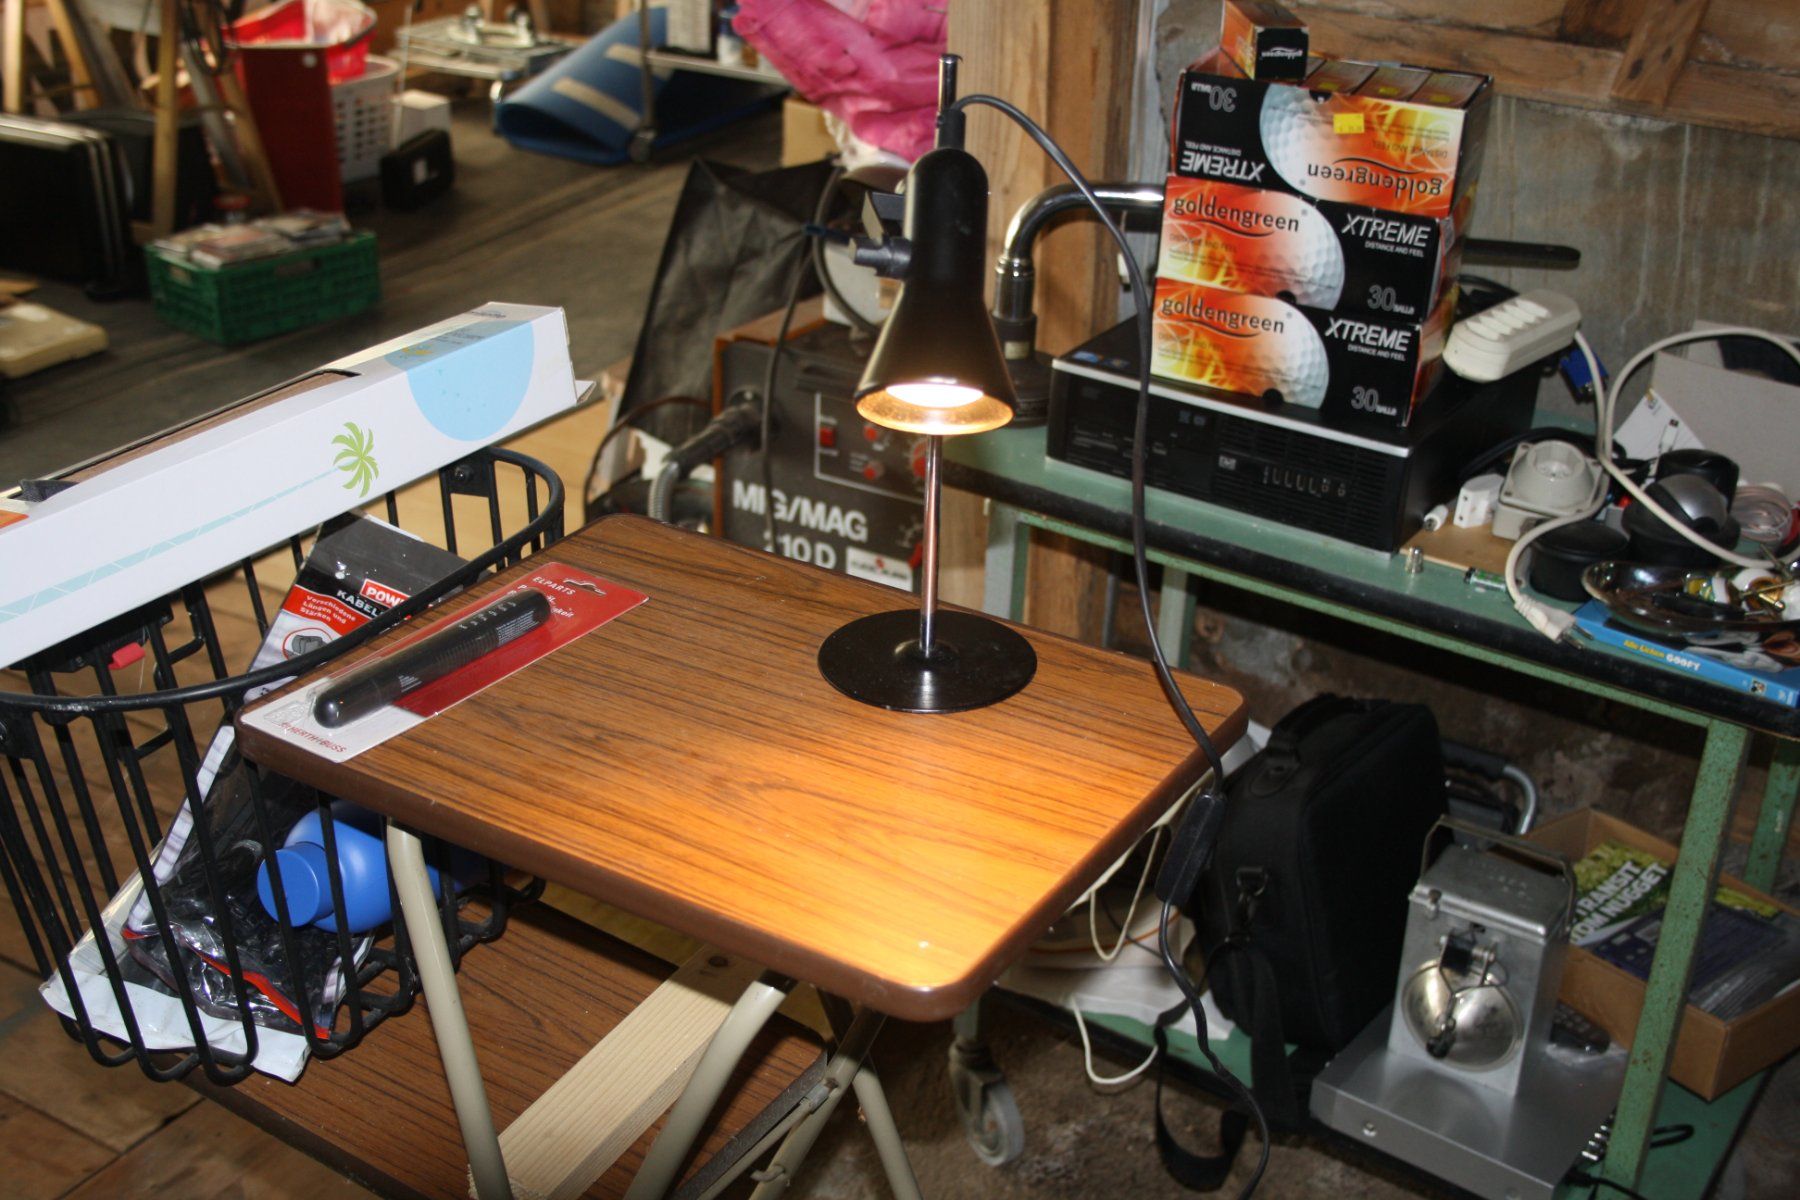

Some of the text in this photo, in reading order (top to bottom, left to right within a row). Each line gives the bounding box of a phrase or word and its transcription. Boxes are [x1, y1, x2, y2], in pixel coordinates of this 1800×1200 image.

[1209, 86, 1237, 112] 30
[1180, 150, 1265, 182] XTREME
[1307, 164, 1443, 200] goldengreen
[1172, 195, 1299, 232] goldengreen
[1341, 213, 1431, 248] XTREME
[1367, 284, 1397, 312] 30
[1161, 295, 1285, 333] goldengreen
[1324, 317, 1411, 352] XTREME
[1350, 386, 1380, 413] 30
[366, 586, 405, 607] POW
[532, 576, 576, 596] ELPARTS
[299, 606, 332, 622] Stärken
[302, 600, 347, 624] Längen und
[306, 594, 357, 622] Verschiedene
[336, 589, 384, 618] KABEL
[1665, 652, 1701, 672] GOOFY
[1600, 862, 1668, 918] NUGGET
